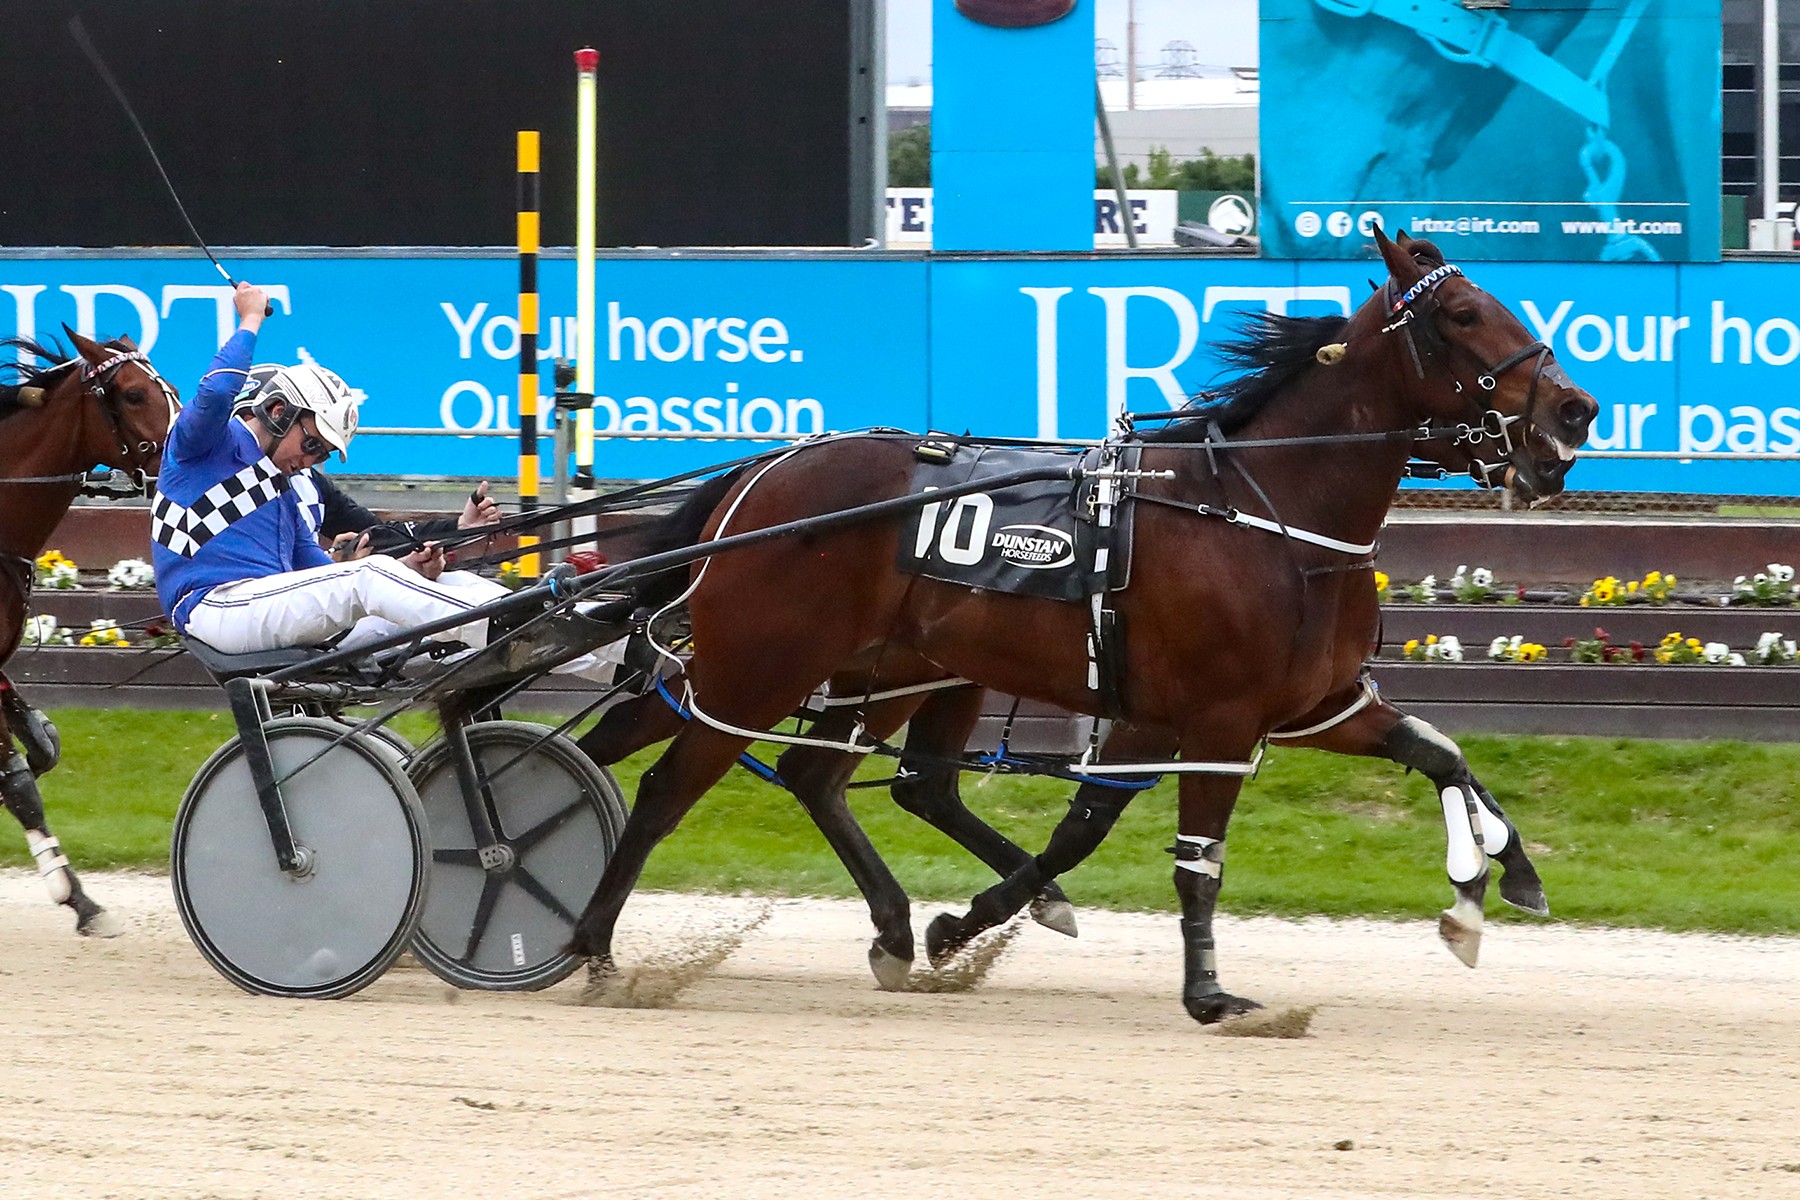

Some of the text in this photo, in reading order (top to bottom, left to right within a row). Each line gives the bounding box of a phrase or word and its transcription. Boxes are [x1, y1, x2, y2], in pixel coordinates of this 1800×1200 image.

[1411, 217, 1682, 236] irtnz@irt.com www.irt.com
[608, 301, 803, 363] horse.
[1519, 300, 1800, 366] Your ho
[1587, 403, 1800, 464] ur pas
[914, 486, 994, 566] 10
[991, 532, 1065, 555] DUNSTAN
[1000, 547, 1052, 562] HORSEFEEDS
